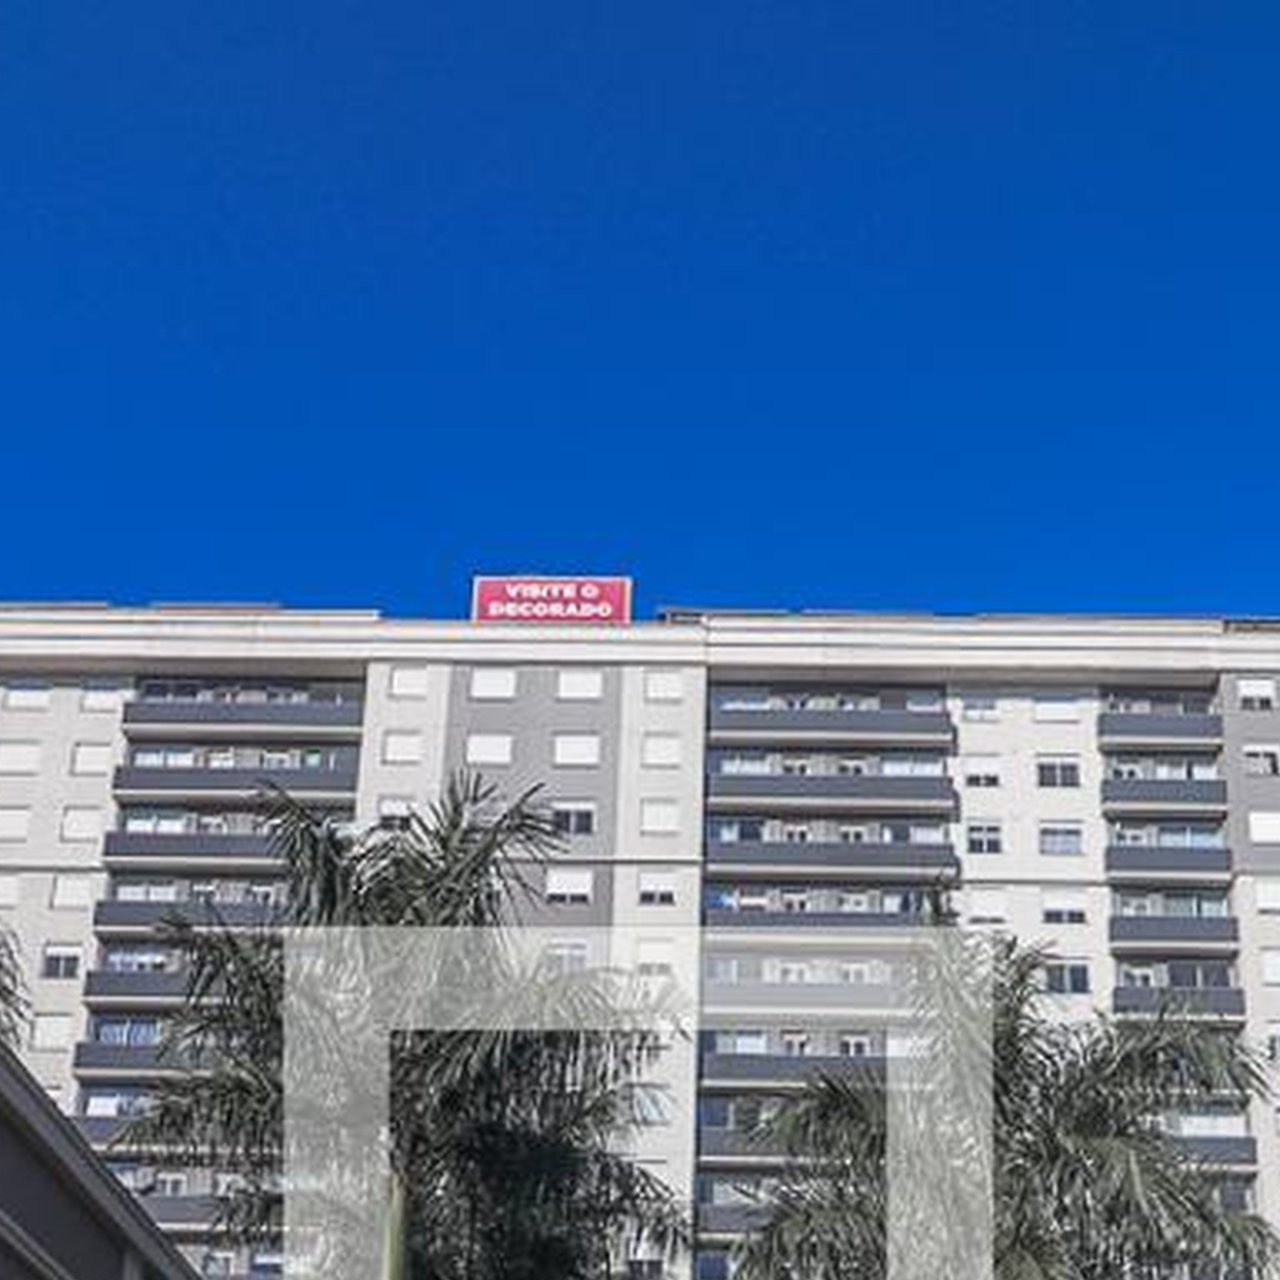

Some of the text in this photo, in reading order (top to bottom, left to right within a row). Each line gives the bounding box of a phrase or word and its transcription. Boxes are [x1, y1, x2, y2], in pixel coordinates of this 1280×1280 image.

[505, 583, 600, 599] VISITE O
[488, 601, 613, 618] DECORADO
